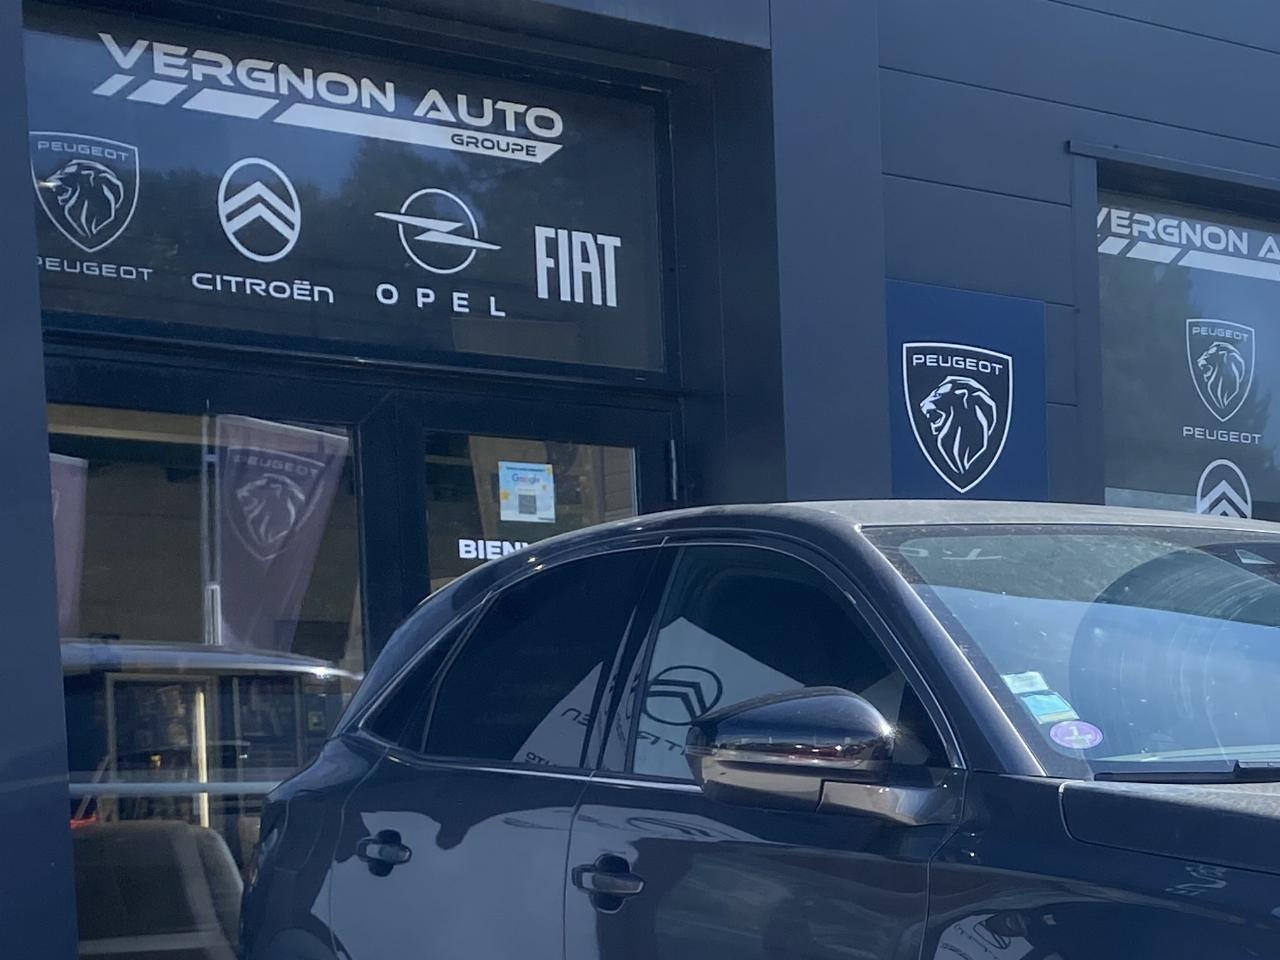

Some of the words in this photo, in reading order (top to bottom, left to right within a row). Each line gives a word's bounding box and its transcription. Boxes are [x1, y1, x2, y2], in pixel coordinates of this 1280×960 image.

[97, 32, 396, 113] VERGNON
[413, 89, 563, 138] AUTO
[37, 140, 129, 161] PEUGEOT
[450, 132, 537, 157] GROUPE
[534, 225, 621, 308] FIAT
[376, 282, 506, 318] OPEL
[1192, 326, 1249, 342] PEUGEOT
[912, 354, 1003, 375] PEUGEOT
[1183, 426, 1262, 444] PEUGEOT
